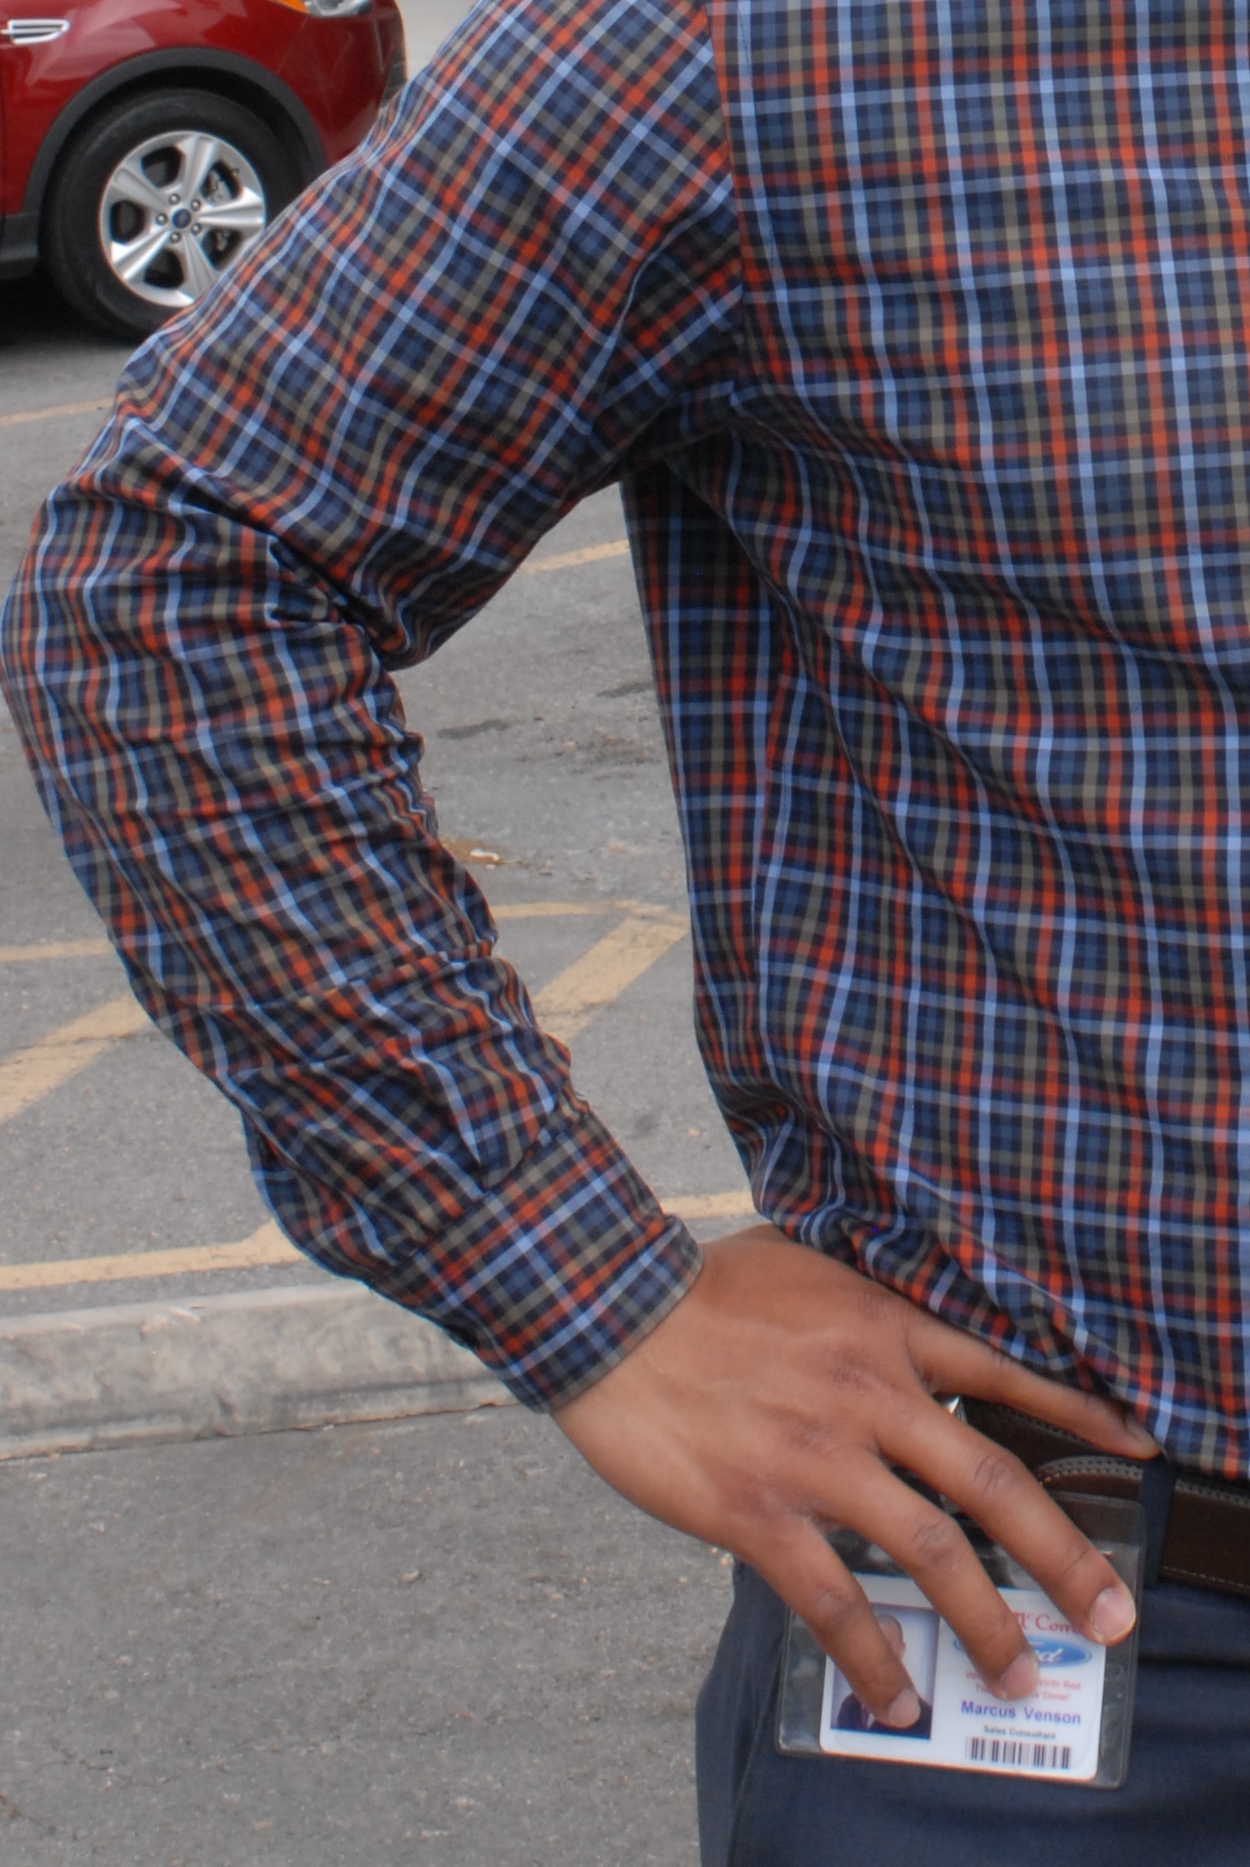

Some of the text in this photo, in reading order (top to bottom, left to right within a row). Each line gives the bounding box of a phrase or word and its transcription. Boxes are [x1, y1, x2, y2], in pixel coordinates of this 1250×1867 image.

[961, 1700, 1082, 1725] Marcus Venson
[984, 1725, 1056, 1740] Sales Consultant
